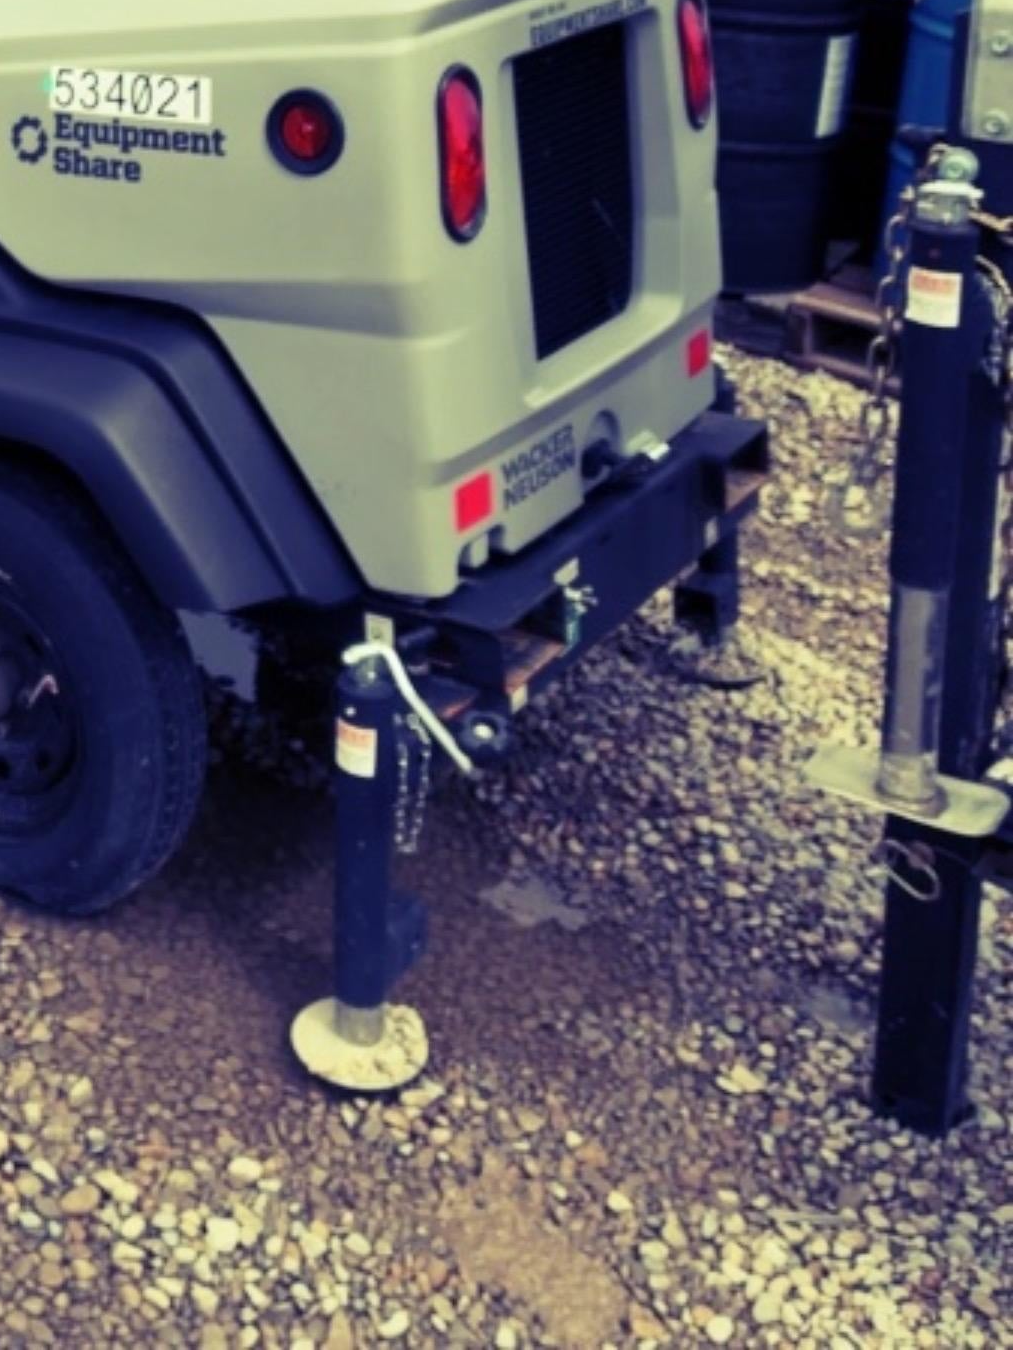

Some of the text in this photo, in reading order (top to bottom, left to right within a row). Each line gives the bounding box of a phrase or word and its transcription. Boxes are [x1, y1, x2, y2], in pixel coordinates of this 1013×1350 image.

[52, 67, 203, 119] 534021
[53, 112, 227, 157] Equipment
[52, 146, 142, 183] Share
[501, 424, 573, 481] WACKER
[504, 451, 575, 510] NEUSON
